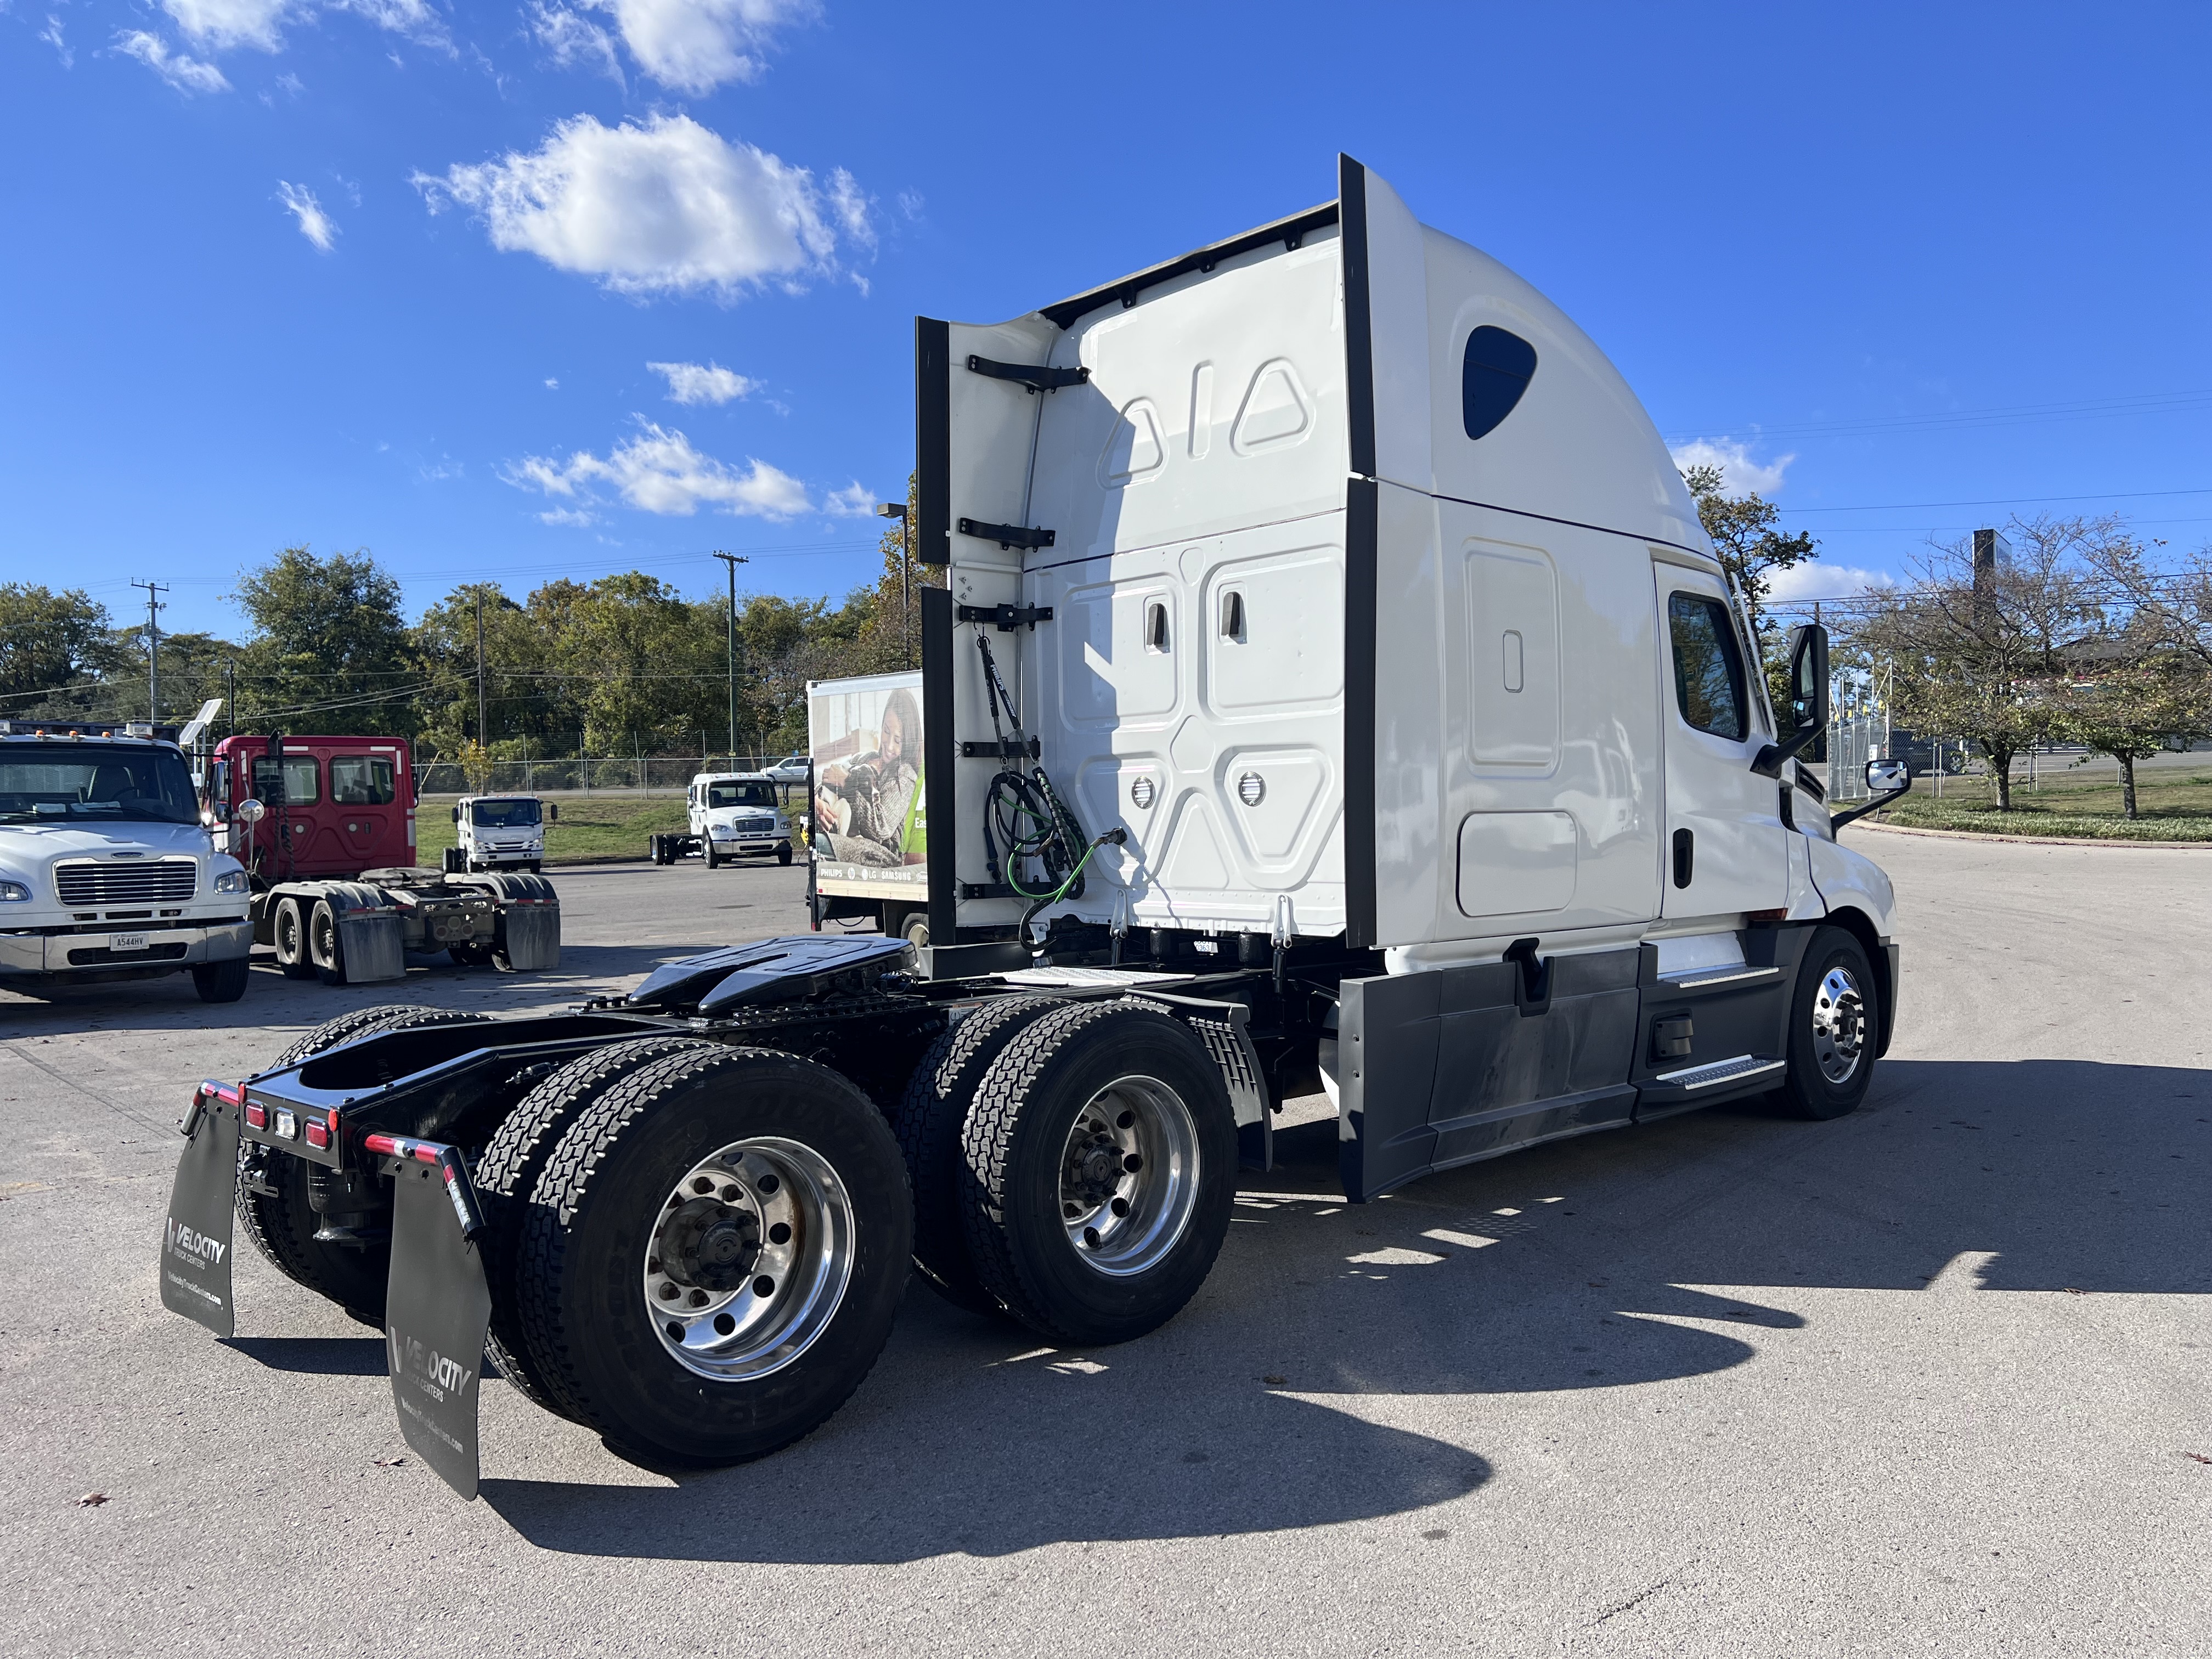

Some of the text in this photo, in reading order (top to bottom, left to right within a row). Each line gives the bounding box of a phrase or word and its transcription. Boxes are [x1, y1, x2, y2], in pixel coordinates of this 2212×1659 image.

[821, 868, 843, 877] PHILIPS
[869, 870, 877, 879] LG
[882, 871, 911, 881] SAMSUNG
[117, 937, 143, 946] A544HV
[176, 1223, 225, 1264] VELOCITY
[174, 1246, 206, 1270] TRUCK CENTERS
[167, 1270, 222, 1305] VelocityTruckCenters.com
[405, 1336, 472, 1396] VELOCITY
[420, 1378, 444, 1403] CENTERS
